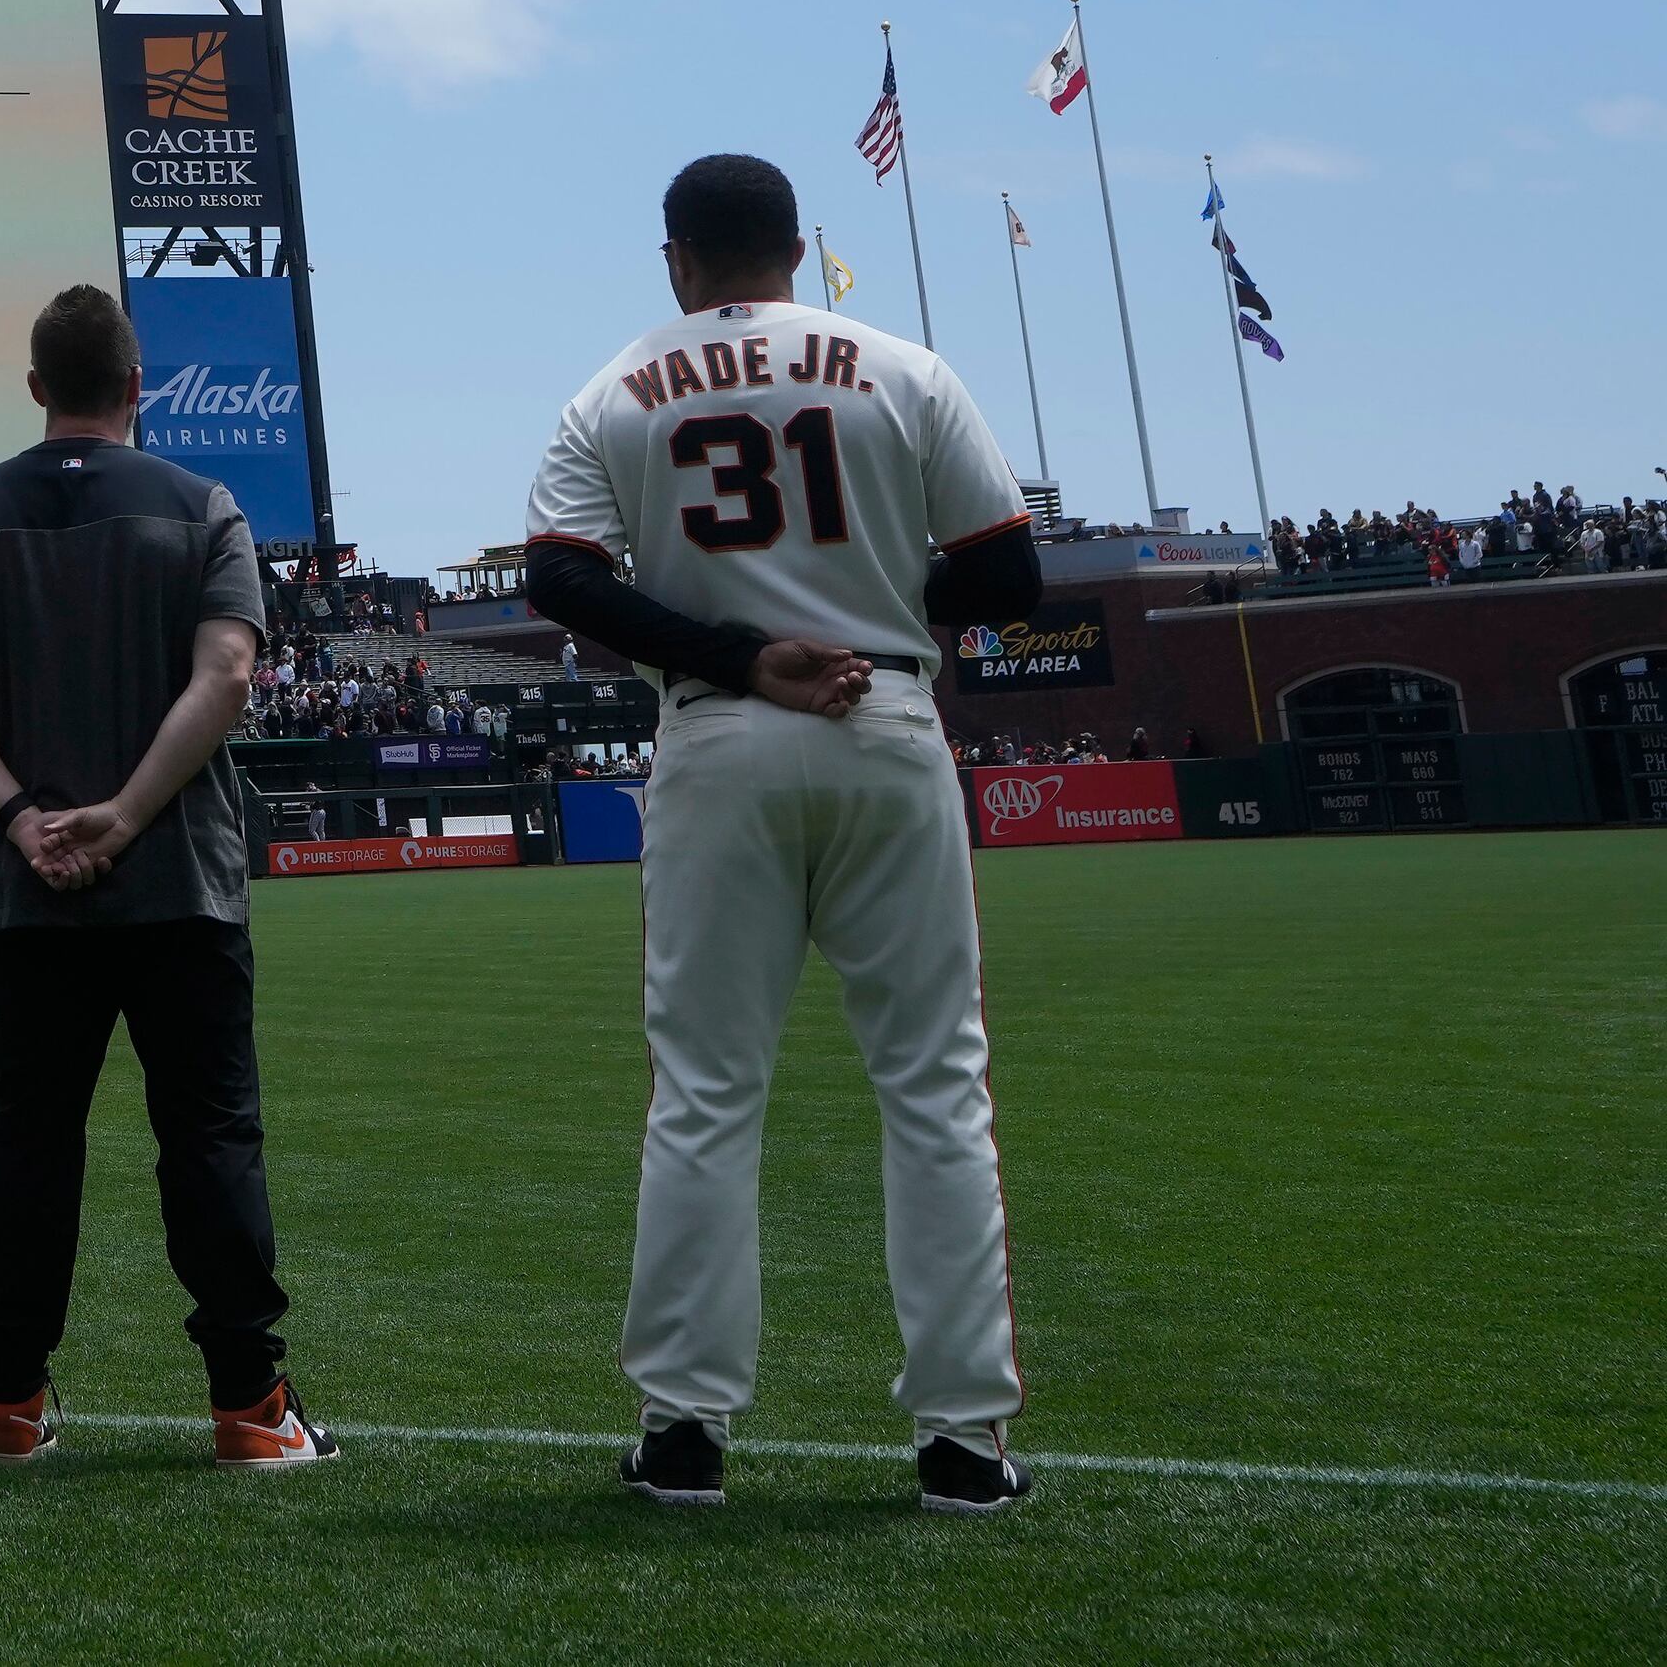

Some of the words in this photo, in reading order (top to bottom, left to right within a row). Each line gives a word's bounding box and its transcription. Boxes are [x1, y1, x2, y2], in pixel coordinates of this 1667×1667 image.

[125, 129, 257, 155] CACHE
[131, 160, 257, 186] CREEK
[130, 194, 194, 209] CASINO
[199, 193, 263, 208] RESORT
[622, 336, 774, 412] WADE
[788, 333, 874, 393] JR.
[139, 364, 300, 421] Alaska
[146, 428, 287, 446] AIRLINES
[669, 406, 850, 553] 31
[1156, 542, 1203, 562] Coors
[1203, 547, 1241, 560] LIGHT
[998, 622, 1100, 660] Sports
[981, 659, 1021, 677] BAY
[1025, 655, 1081, 674] AREA
[1625, 682, 1659, 700] BAL
[1632, 703, 1664, 723] ATL
[385, 749, 415, 758] StubHub
[446, 744, 464, 752] Official
[465, 743, 482, 752] Ticket
[446, 751, 480, 760] Marketplace
[1318, 752, 1362, 766] BONDS
[1401, 750, 1439, 764] MAYS
[1643, 753, 1667, 772] PH
[990, 780, 1037, 818] AAA
[1055, 806, 1176, 828] Insurance
[1416, 790, 1440, 804] OTT
[1218, 801, 1261, 825] 415
[1339, 811, 1360, 824] 521
[1420, 806, 1444, 820] 511
